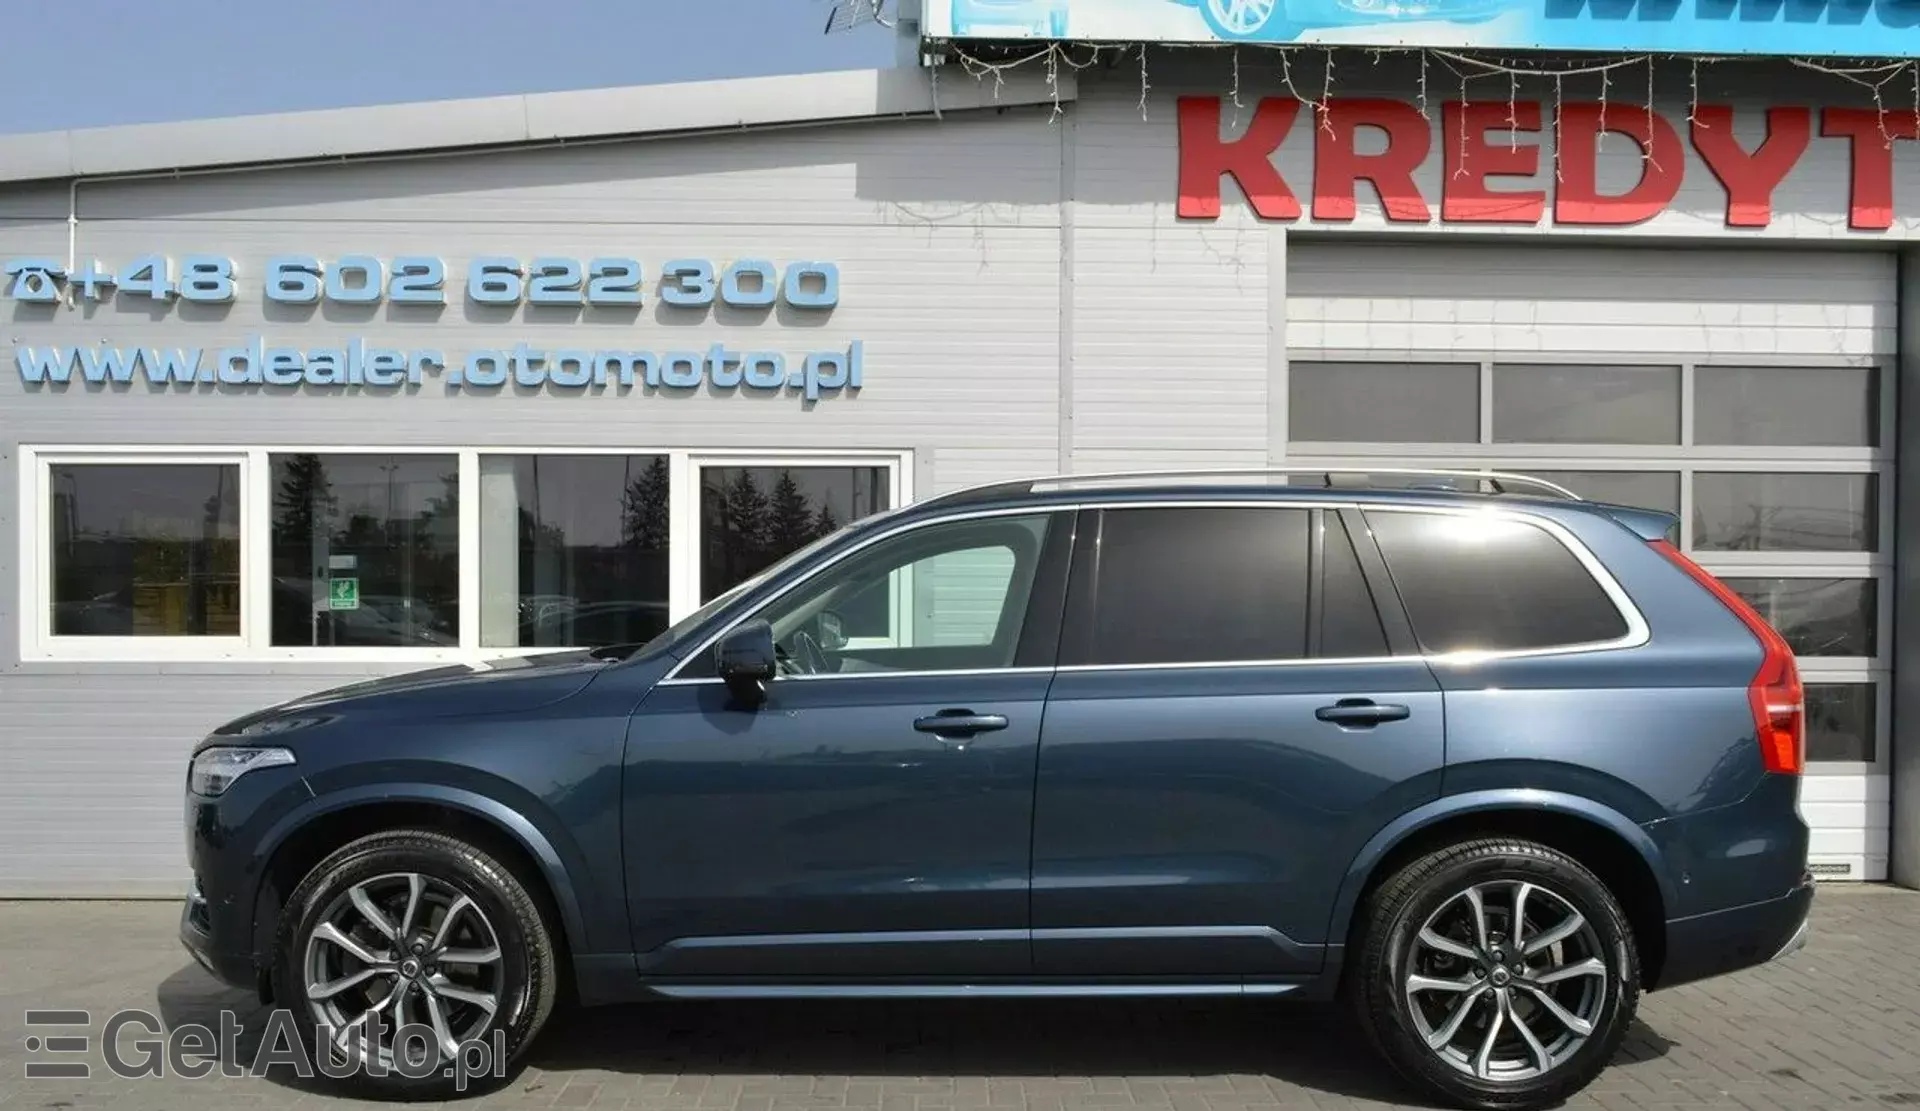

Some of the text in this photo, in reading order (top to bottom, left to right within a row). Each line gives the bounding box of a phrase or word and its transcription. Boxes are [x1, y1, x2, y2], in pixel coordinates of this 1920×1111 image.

[1176, 95, 1920, 230] KREDYT
[68, 253, 840, 309] +48 602 622 300
[15, 332, 864, 401] www.dealer.otomoto.pl
